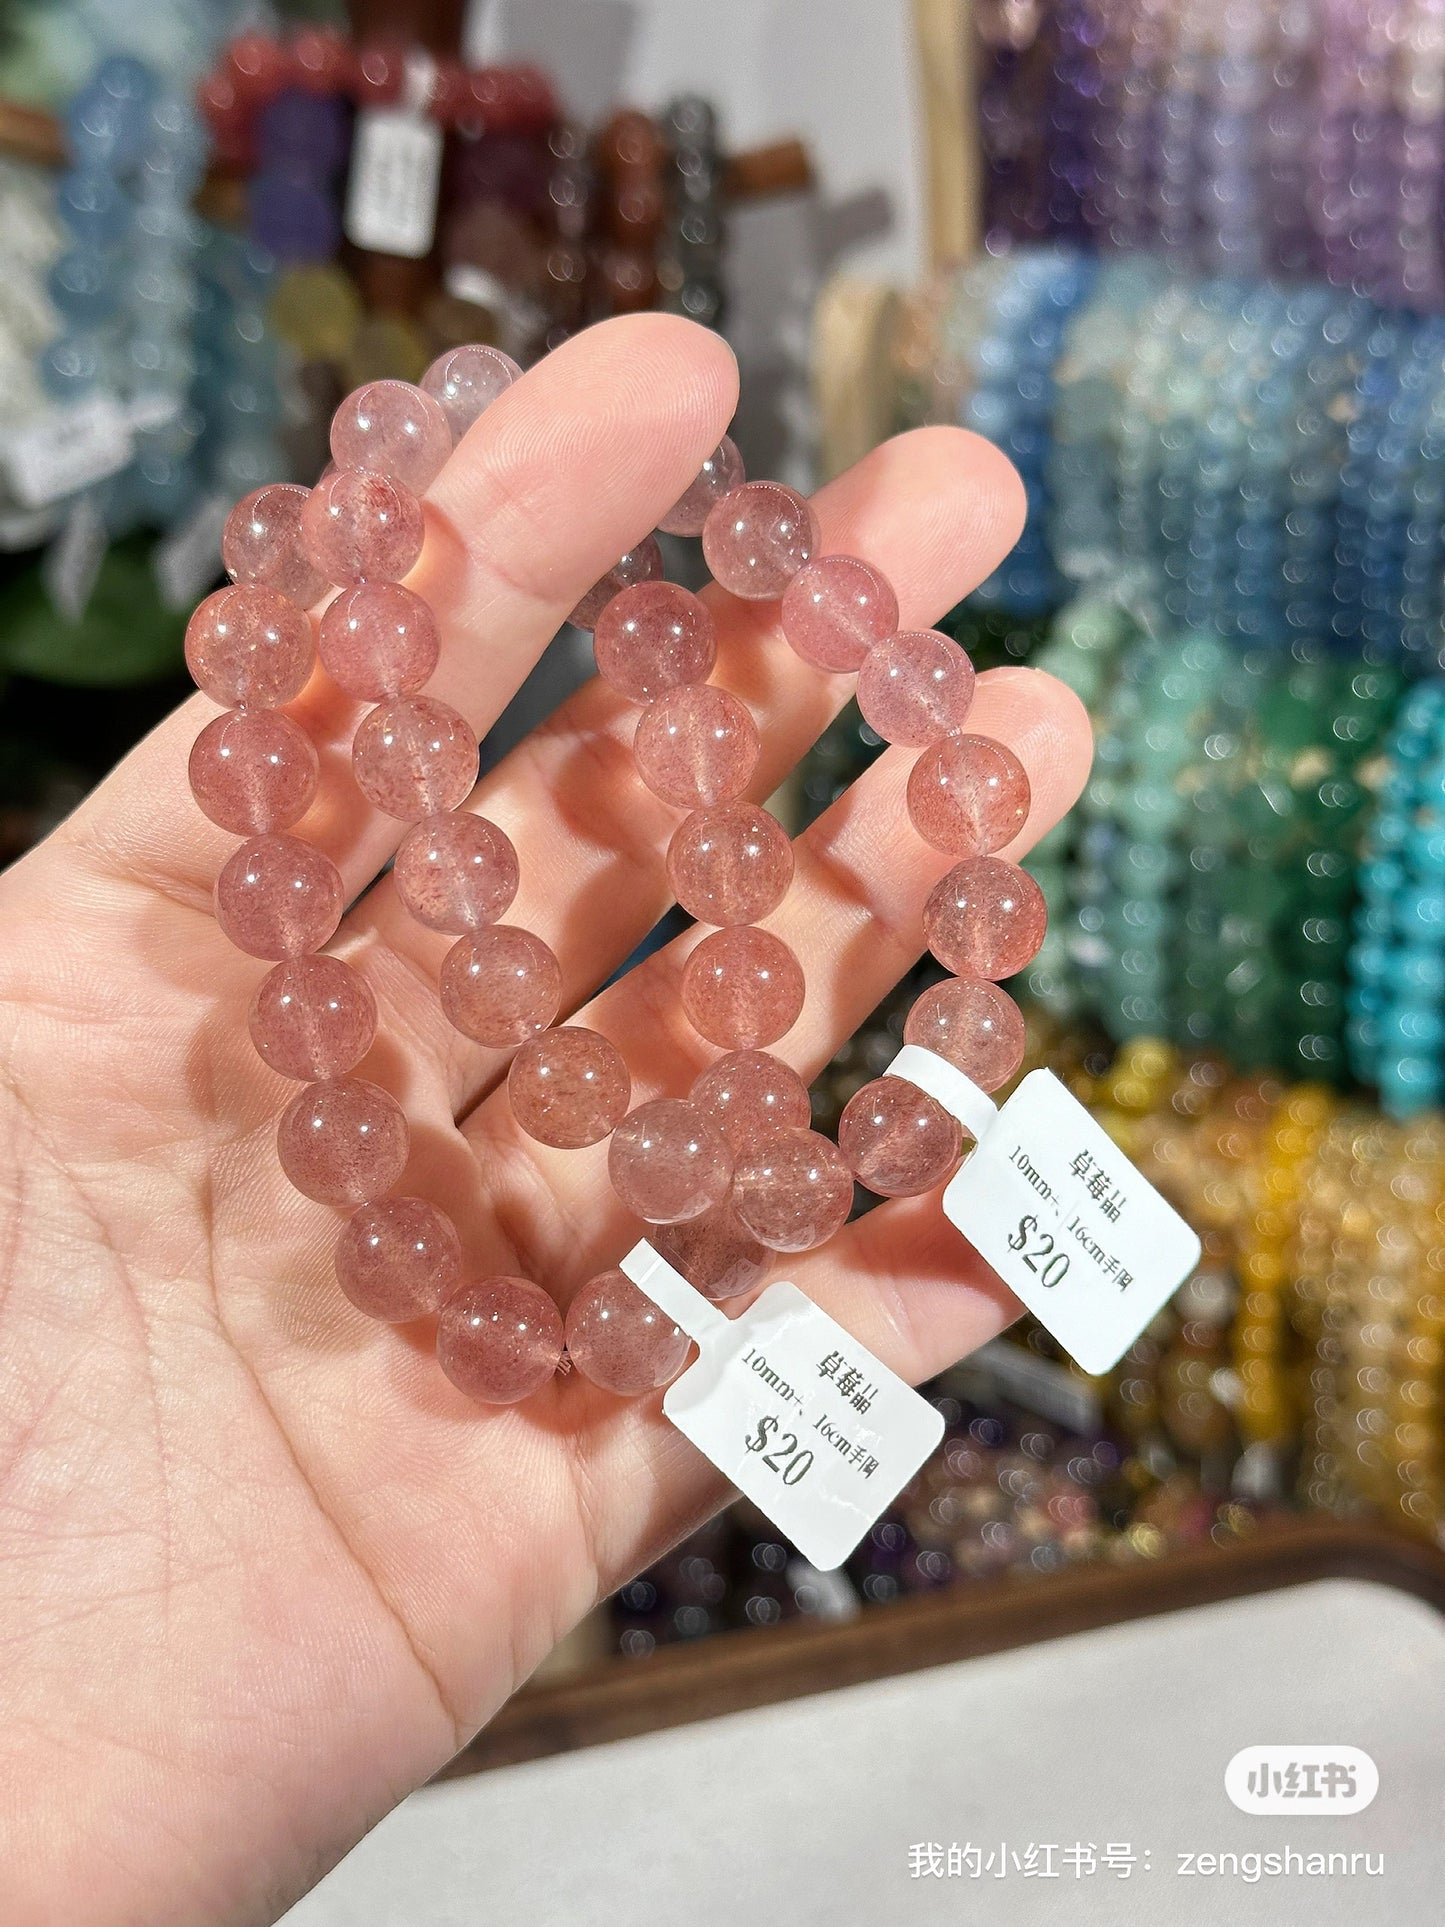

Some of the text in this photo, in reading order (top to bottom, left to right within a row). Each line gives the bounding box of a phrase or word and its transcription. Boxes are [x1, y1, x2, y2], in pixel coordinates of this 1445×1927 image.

[1069, 1149, 1127, 1223] 草莓晶
[1007, 1212, 1070, 1288] $20
[816, 1350, 878, 1415] 草莓晶
[745, 1414, 814, 1485] $20
